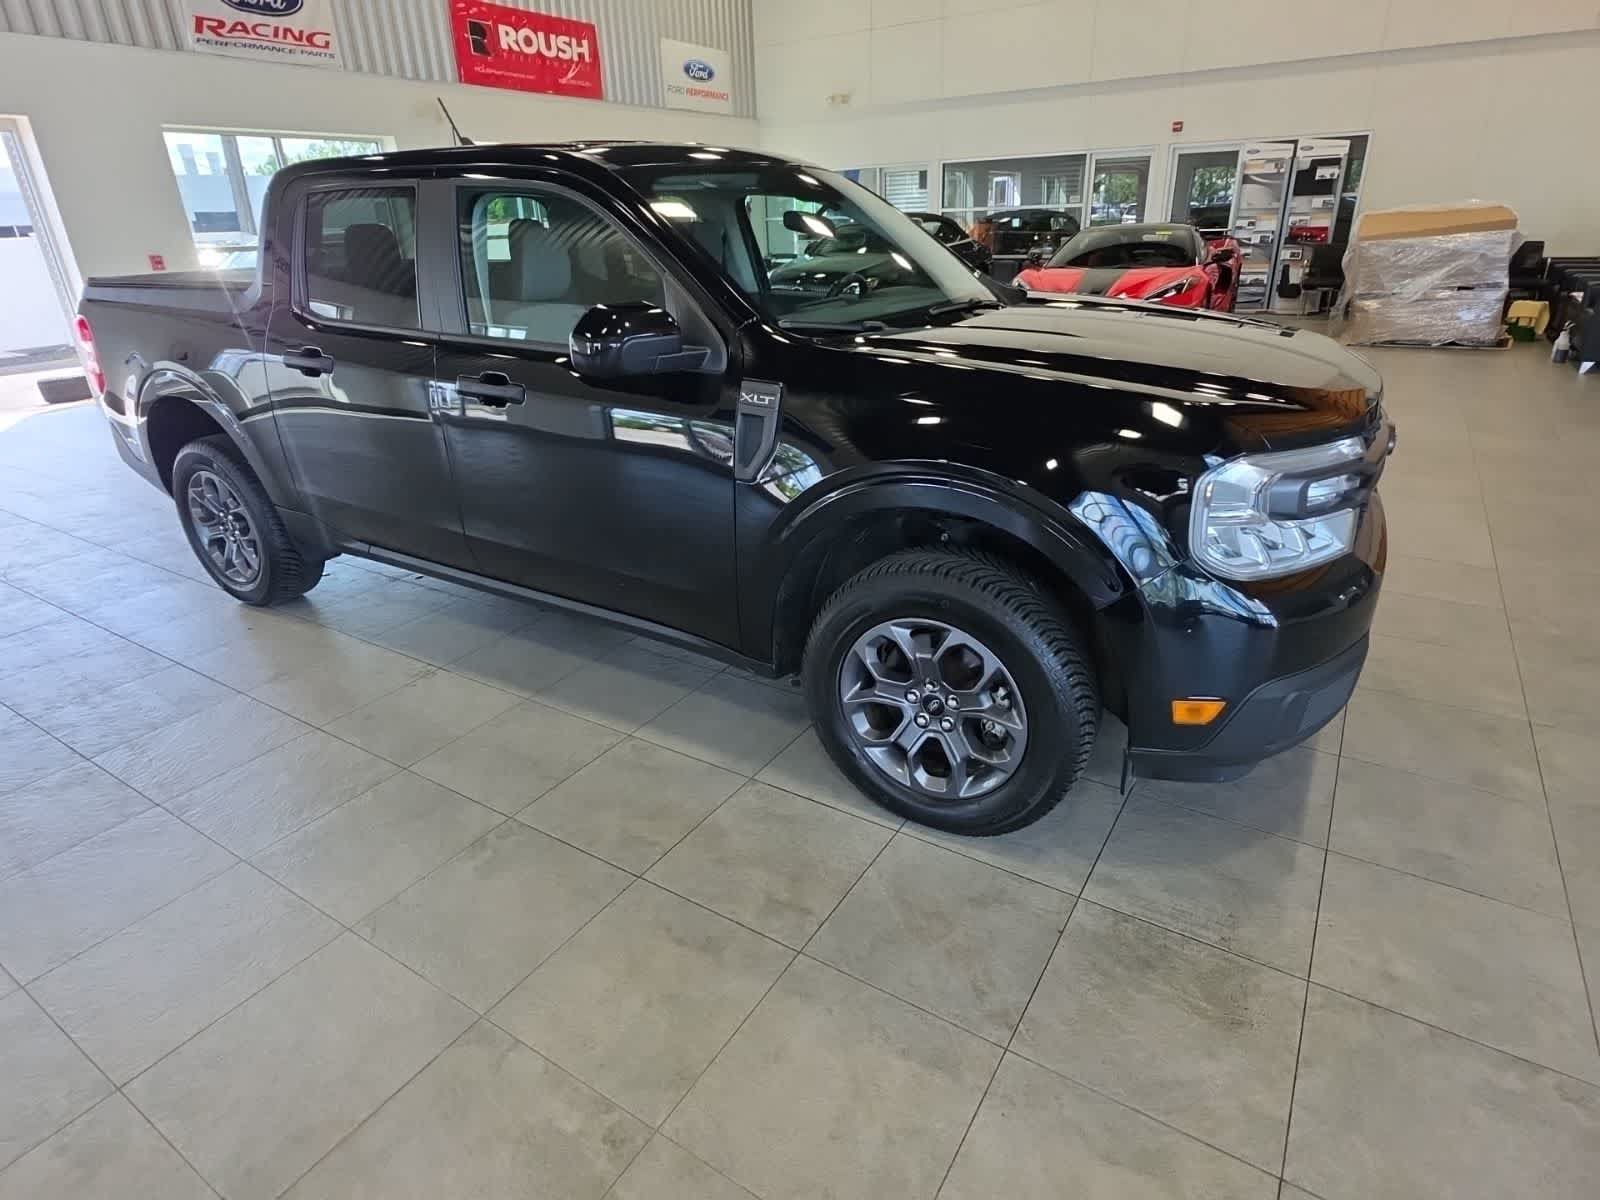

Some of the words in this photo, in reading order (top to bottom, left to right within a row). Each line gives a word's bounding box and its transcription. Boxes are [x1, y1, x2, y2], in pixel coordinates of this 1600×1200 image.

[193, 15, 331, 49] RACING
[498, 24, 591, 63] ROUSH
[195, 37, 297, 55] PERFORMANCE
[300, 50, 336, 60] PARTS
[688, 62, 709, 79] Ford
[740, 392, 775, 405] XLT
